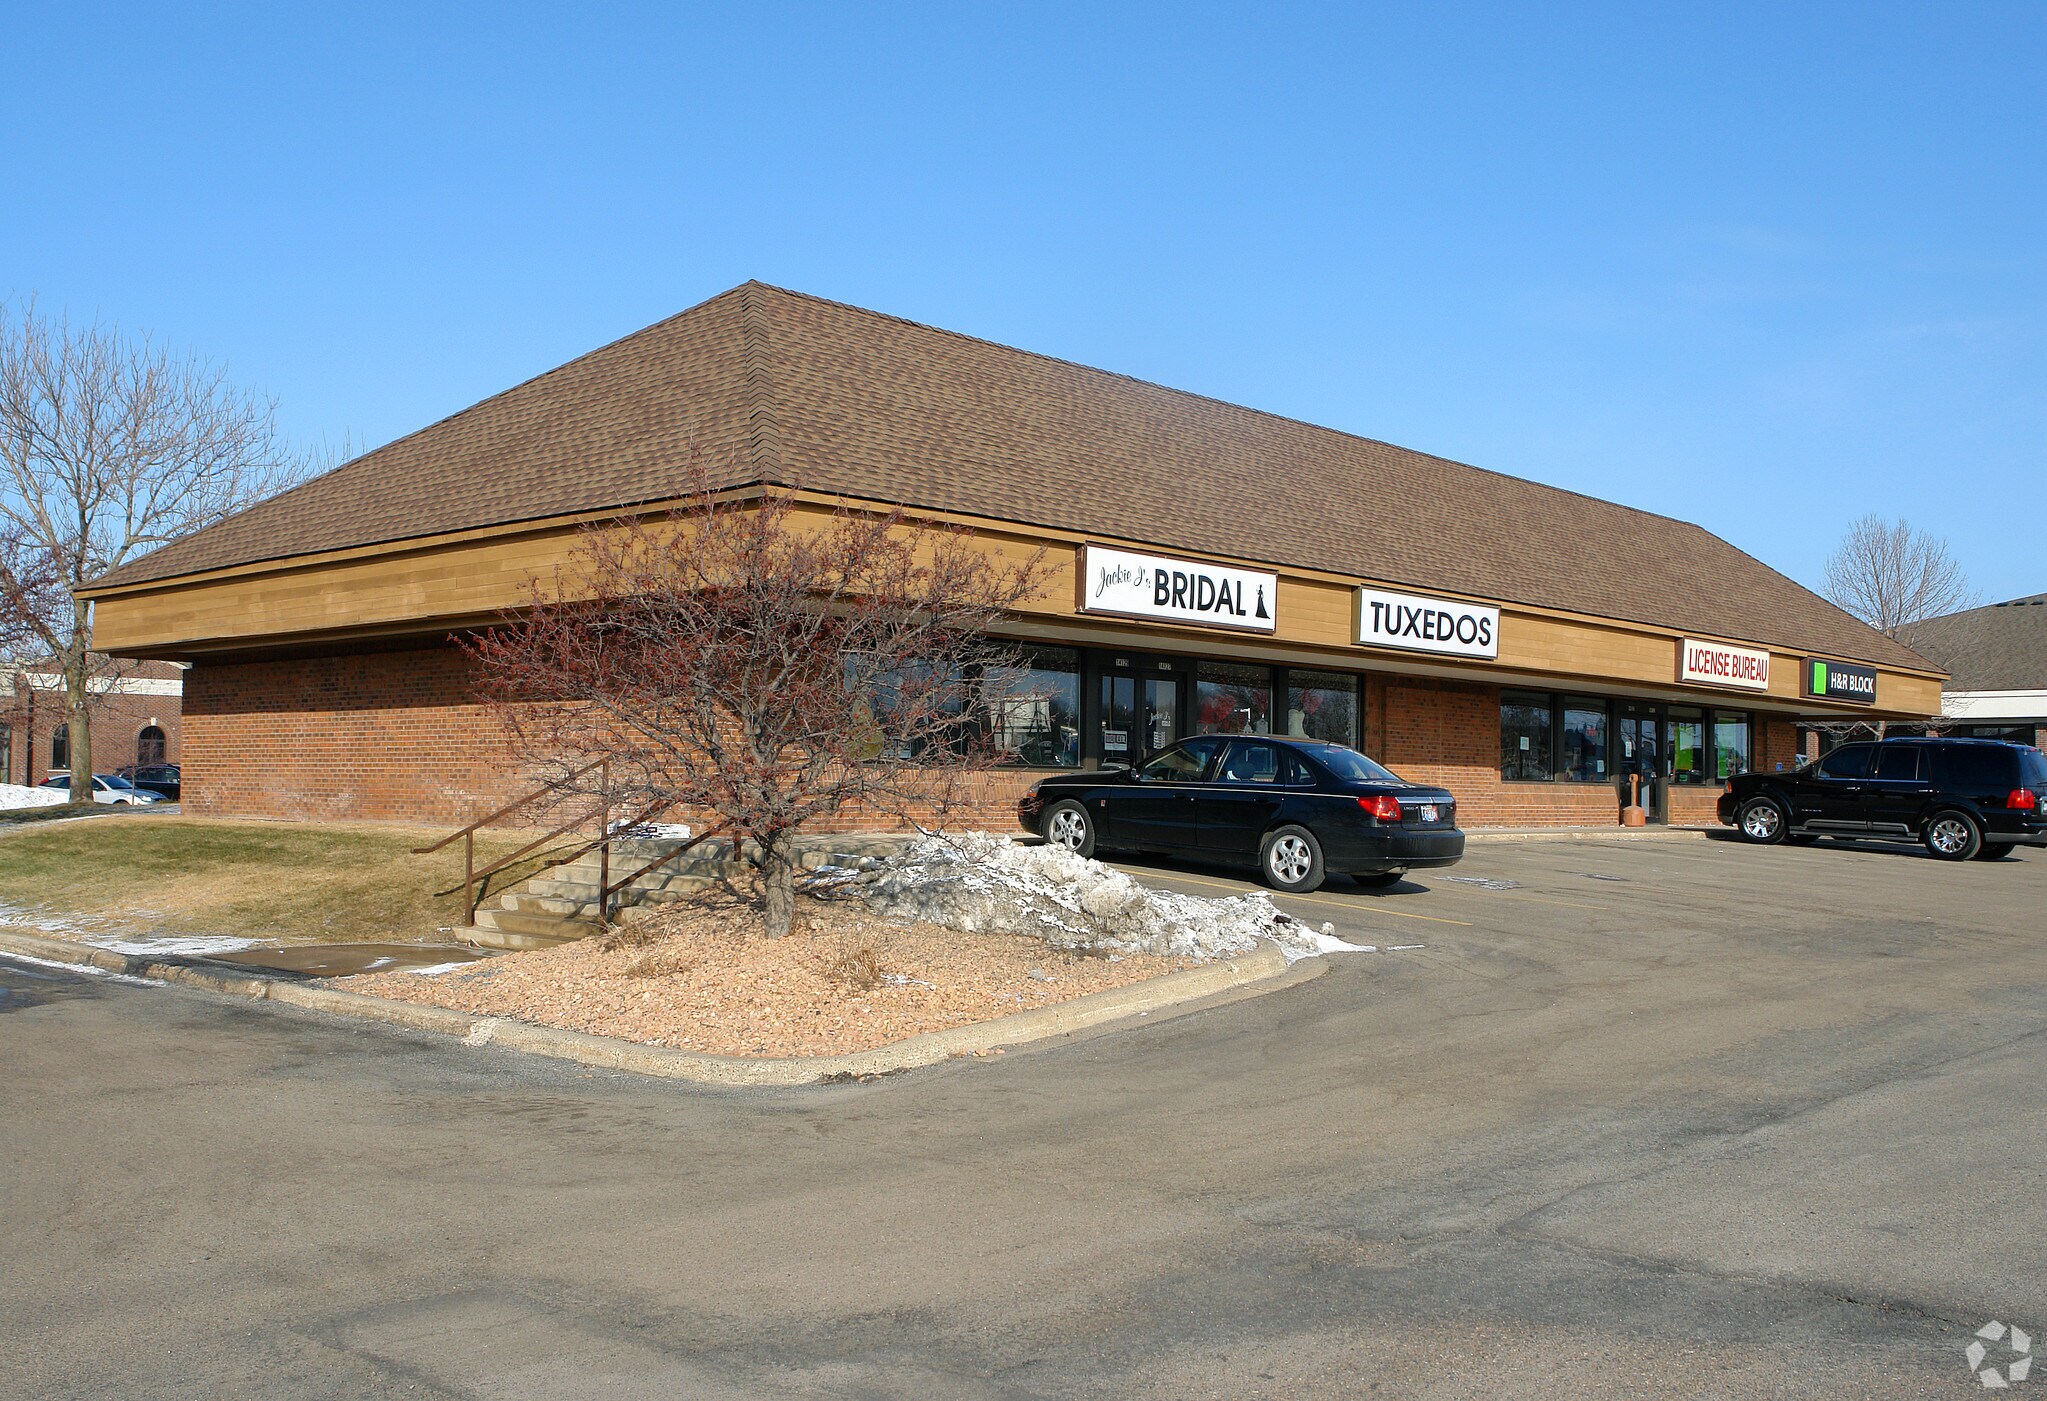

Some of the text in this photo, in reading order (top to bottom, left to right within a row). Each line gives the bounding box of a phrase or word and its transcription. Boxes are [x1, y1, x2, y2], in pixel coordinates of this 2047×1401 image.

[1095, 563, 1132, 598] Jackie
[1153, 568, 1247, 617] BRIDAL
[1370, 601, 1491, 646] TUXEDOS
[1688, 647, 1768, 682] LICENSE BUREAU
[1830, 671, 1874, 694] H&R BLOCK
